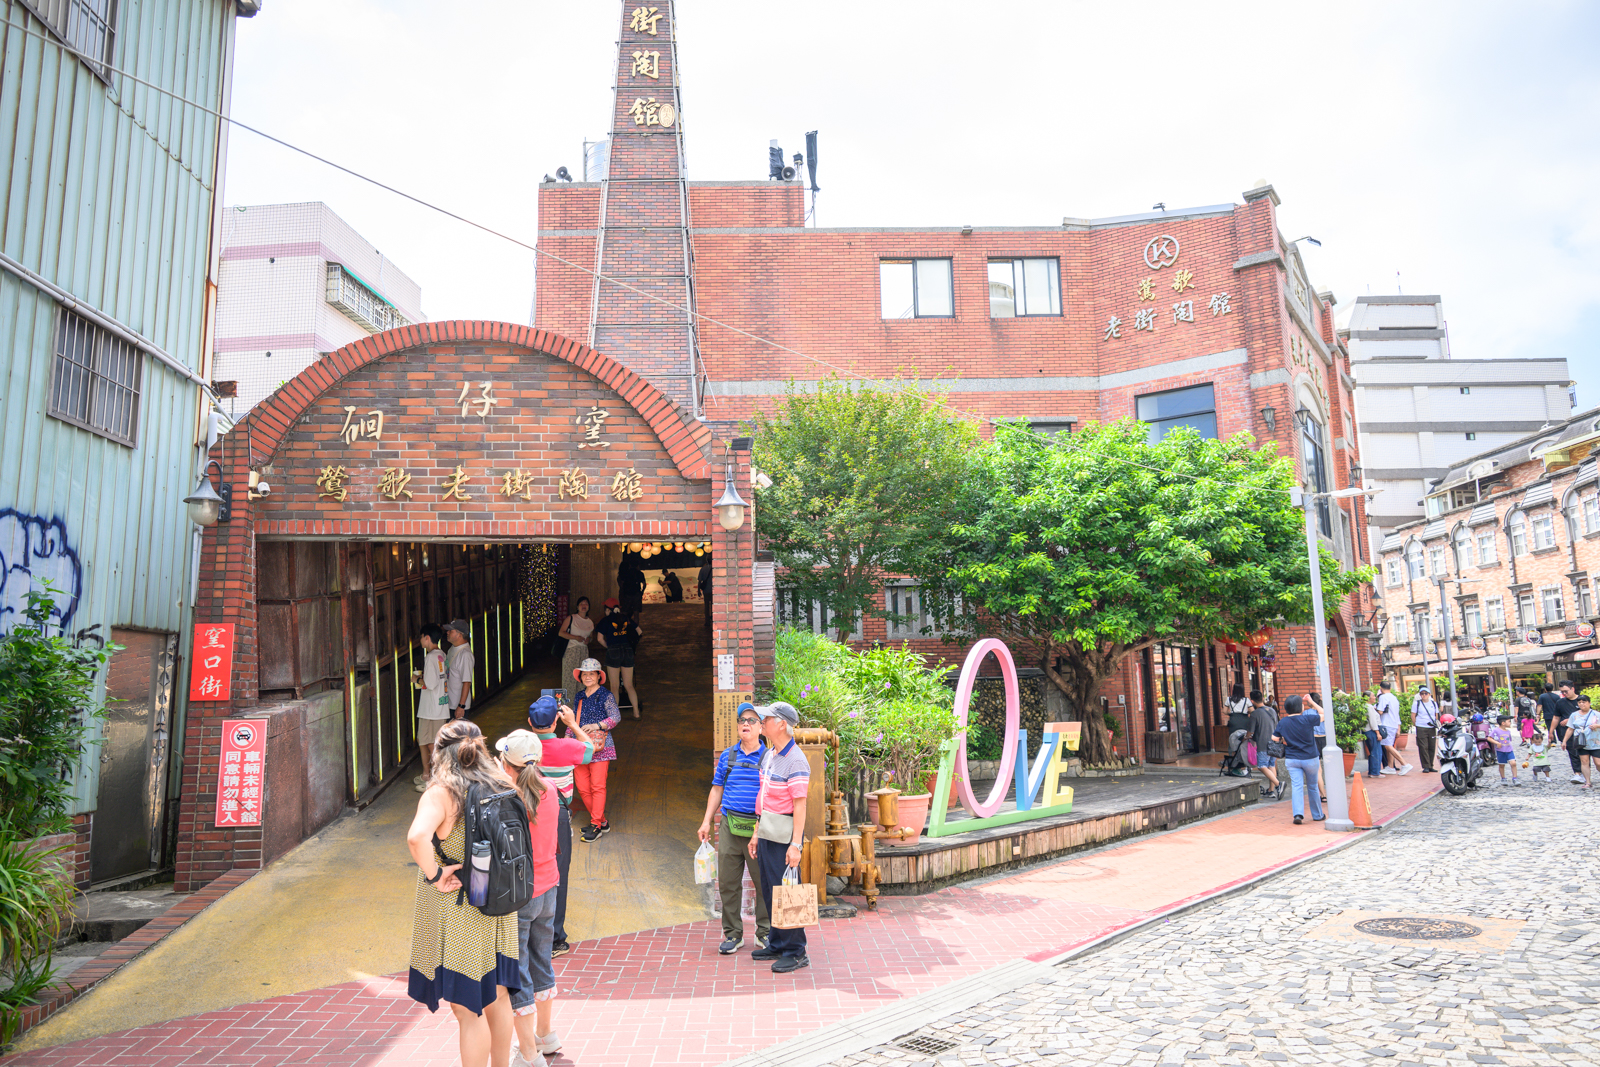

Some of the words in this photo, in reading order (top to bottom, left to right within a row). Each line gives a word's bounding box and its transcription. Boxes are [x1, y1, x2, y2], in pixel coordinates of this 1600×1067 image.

[198, 626, 228, 698] 窯口街
[927, 637, 1082, 838] LOVE
[220, 750, 242, 824] 同意請勿進入
